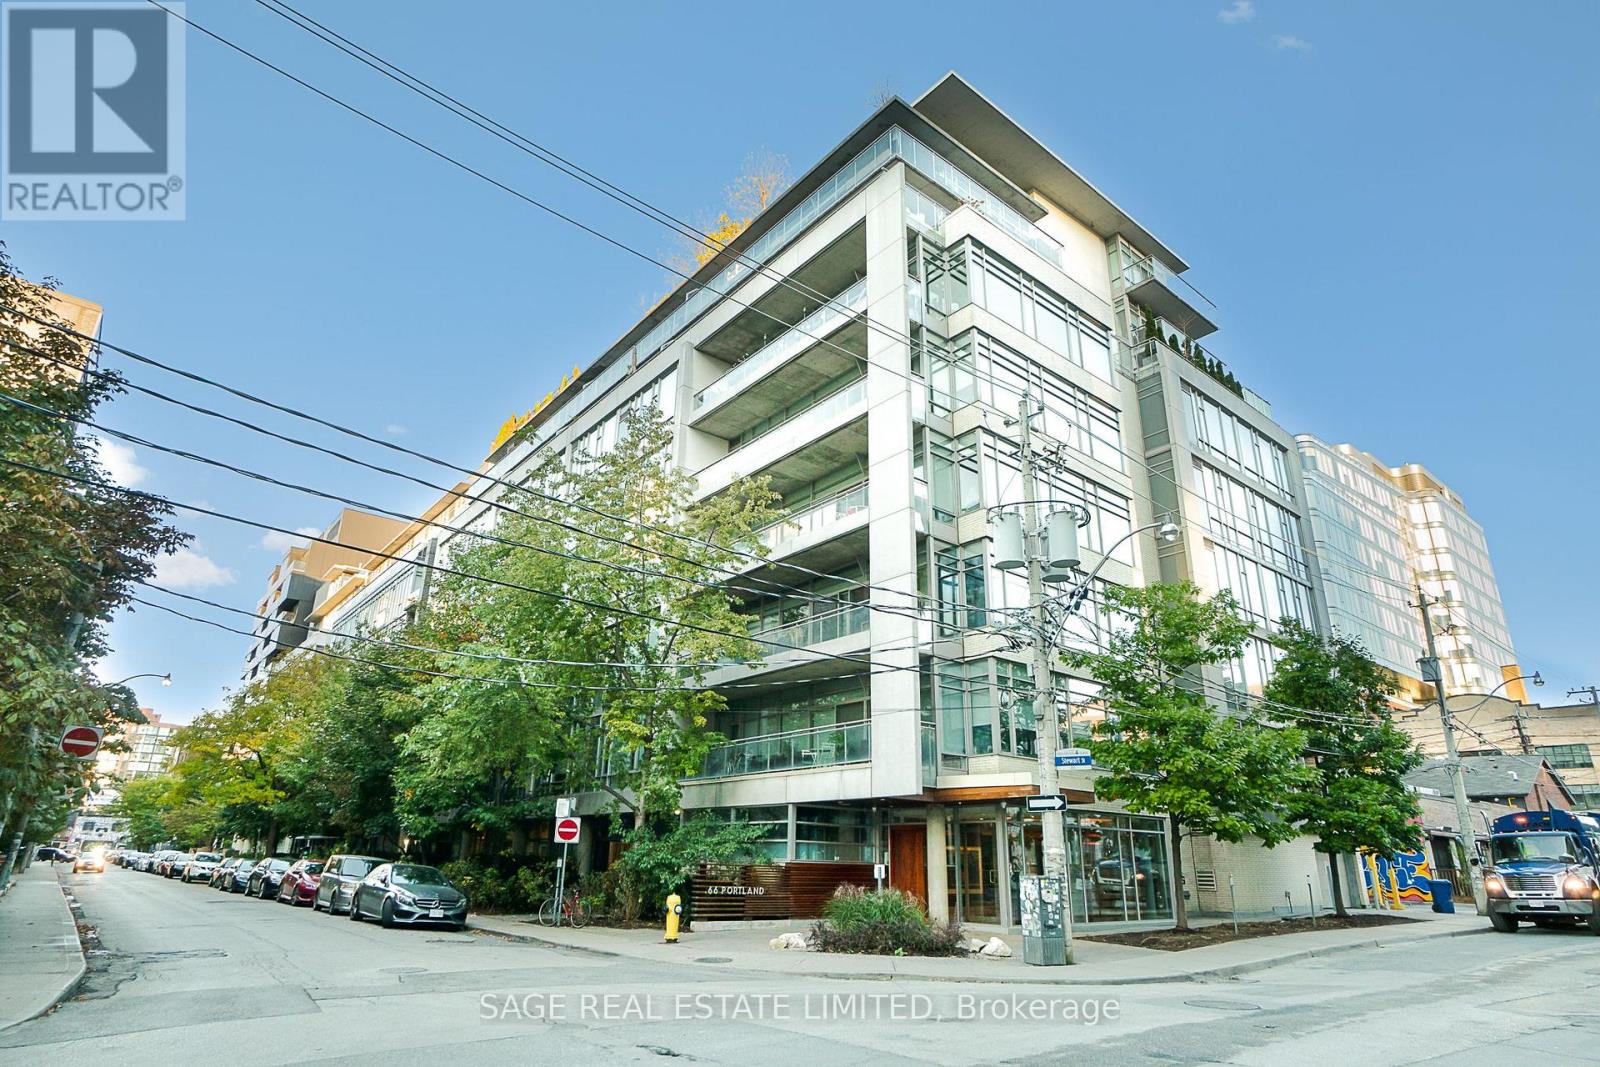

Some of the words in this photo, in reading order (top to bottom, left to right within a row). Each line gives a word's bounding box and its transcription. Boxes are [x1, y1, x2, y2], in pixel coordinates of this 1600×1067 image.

[1061, 757, 1080, 765] Stewart
[707, 886, 719, 895] 66
[721, 886, 764, 895] PORTLAND
